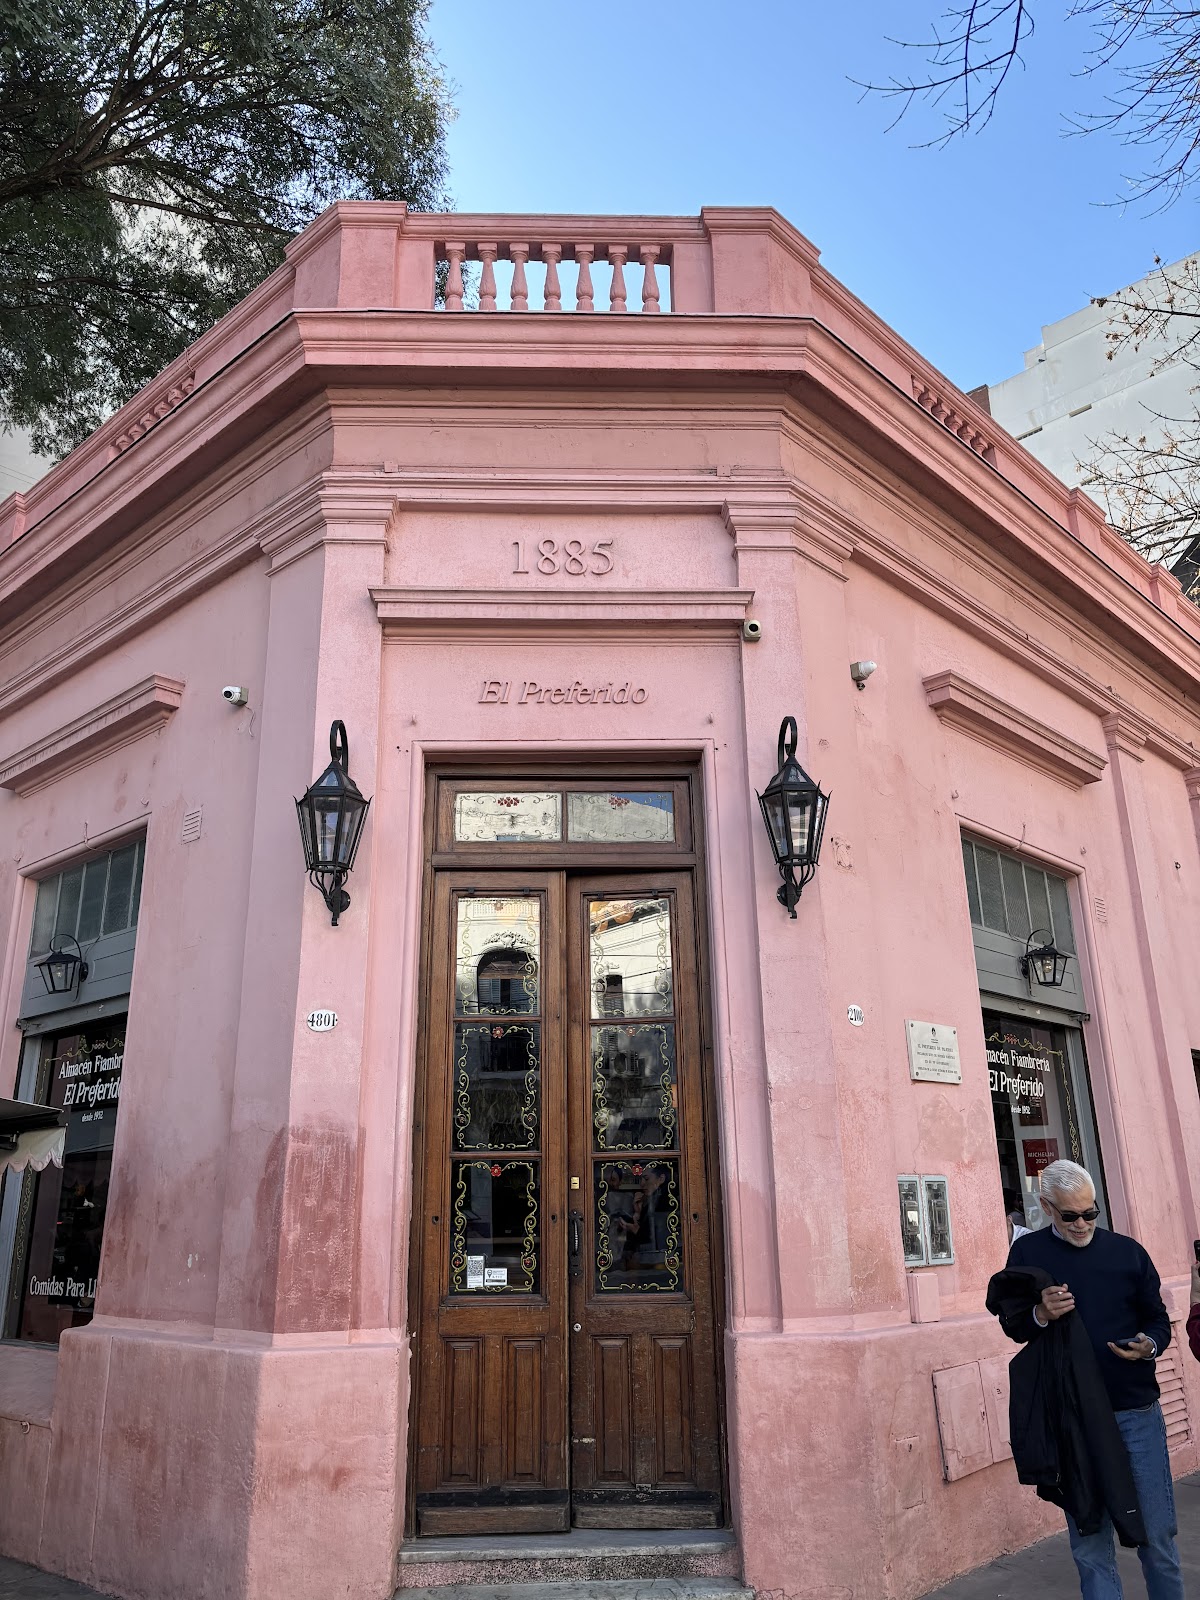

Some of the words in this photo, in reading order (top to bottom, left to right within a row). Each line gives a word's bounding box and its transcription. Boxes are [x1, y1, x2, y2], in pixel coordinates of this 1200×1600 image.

[512, 539, 614, 576] 1885
[478, 681, 512, 705] El
[517, 681, 649, 705] Preferido
[309, 1013, 336, 1027] 4801
[58, 1059, 92, 1079] Almacén
[94, 1053, 123, 1073] Fiambr
[986, 1049, 1010, 1066] macén
[1010, 1049, 1051, 1072] Fiambrería
[62, 1083, 77, 1106] El
[988, 1069, 999, 1092] El
[1000, 1071, 1044, 1100] Preferido
[81, 1113, 93, 1122] desde
[94, 1110, 104, 1120] 1952
[30, 1275, 64, 1296] Comidas
[65, 1277, 85, 1297] Para
